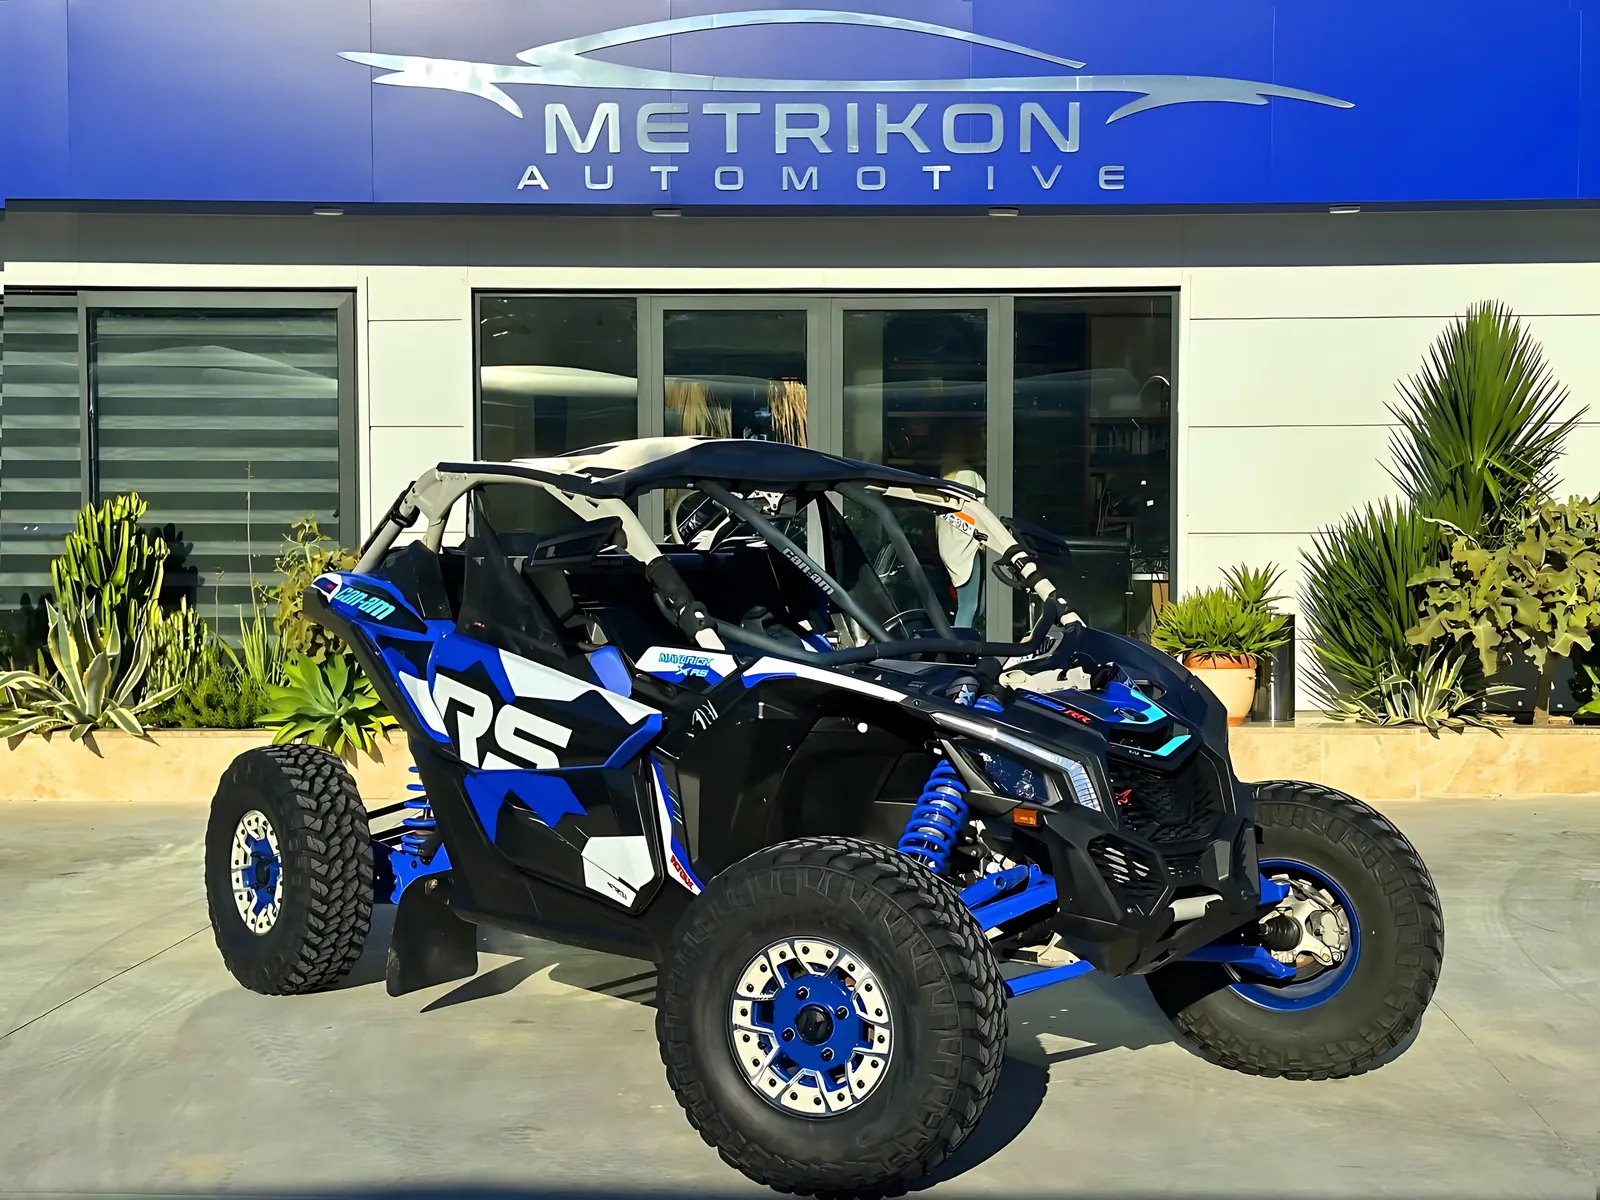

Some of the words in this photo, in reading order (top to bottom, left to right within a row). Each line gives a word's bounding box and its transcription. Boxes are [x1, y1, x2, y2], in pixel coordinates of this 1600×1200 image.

[544, 102, 1080, 154] METRIKON
[517, 165, 1126, 191] AUTOMOTIVE
[782, 548, 834, 595] can-am
[334, 587, 396, 620] can-am
[432, 673, 573, 770] RS
